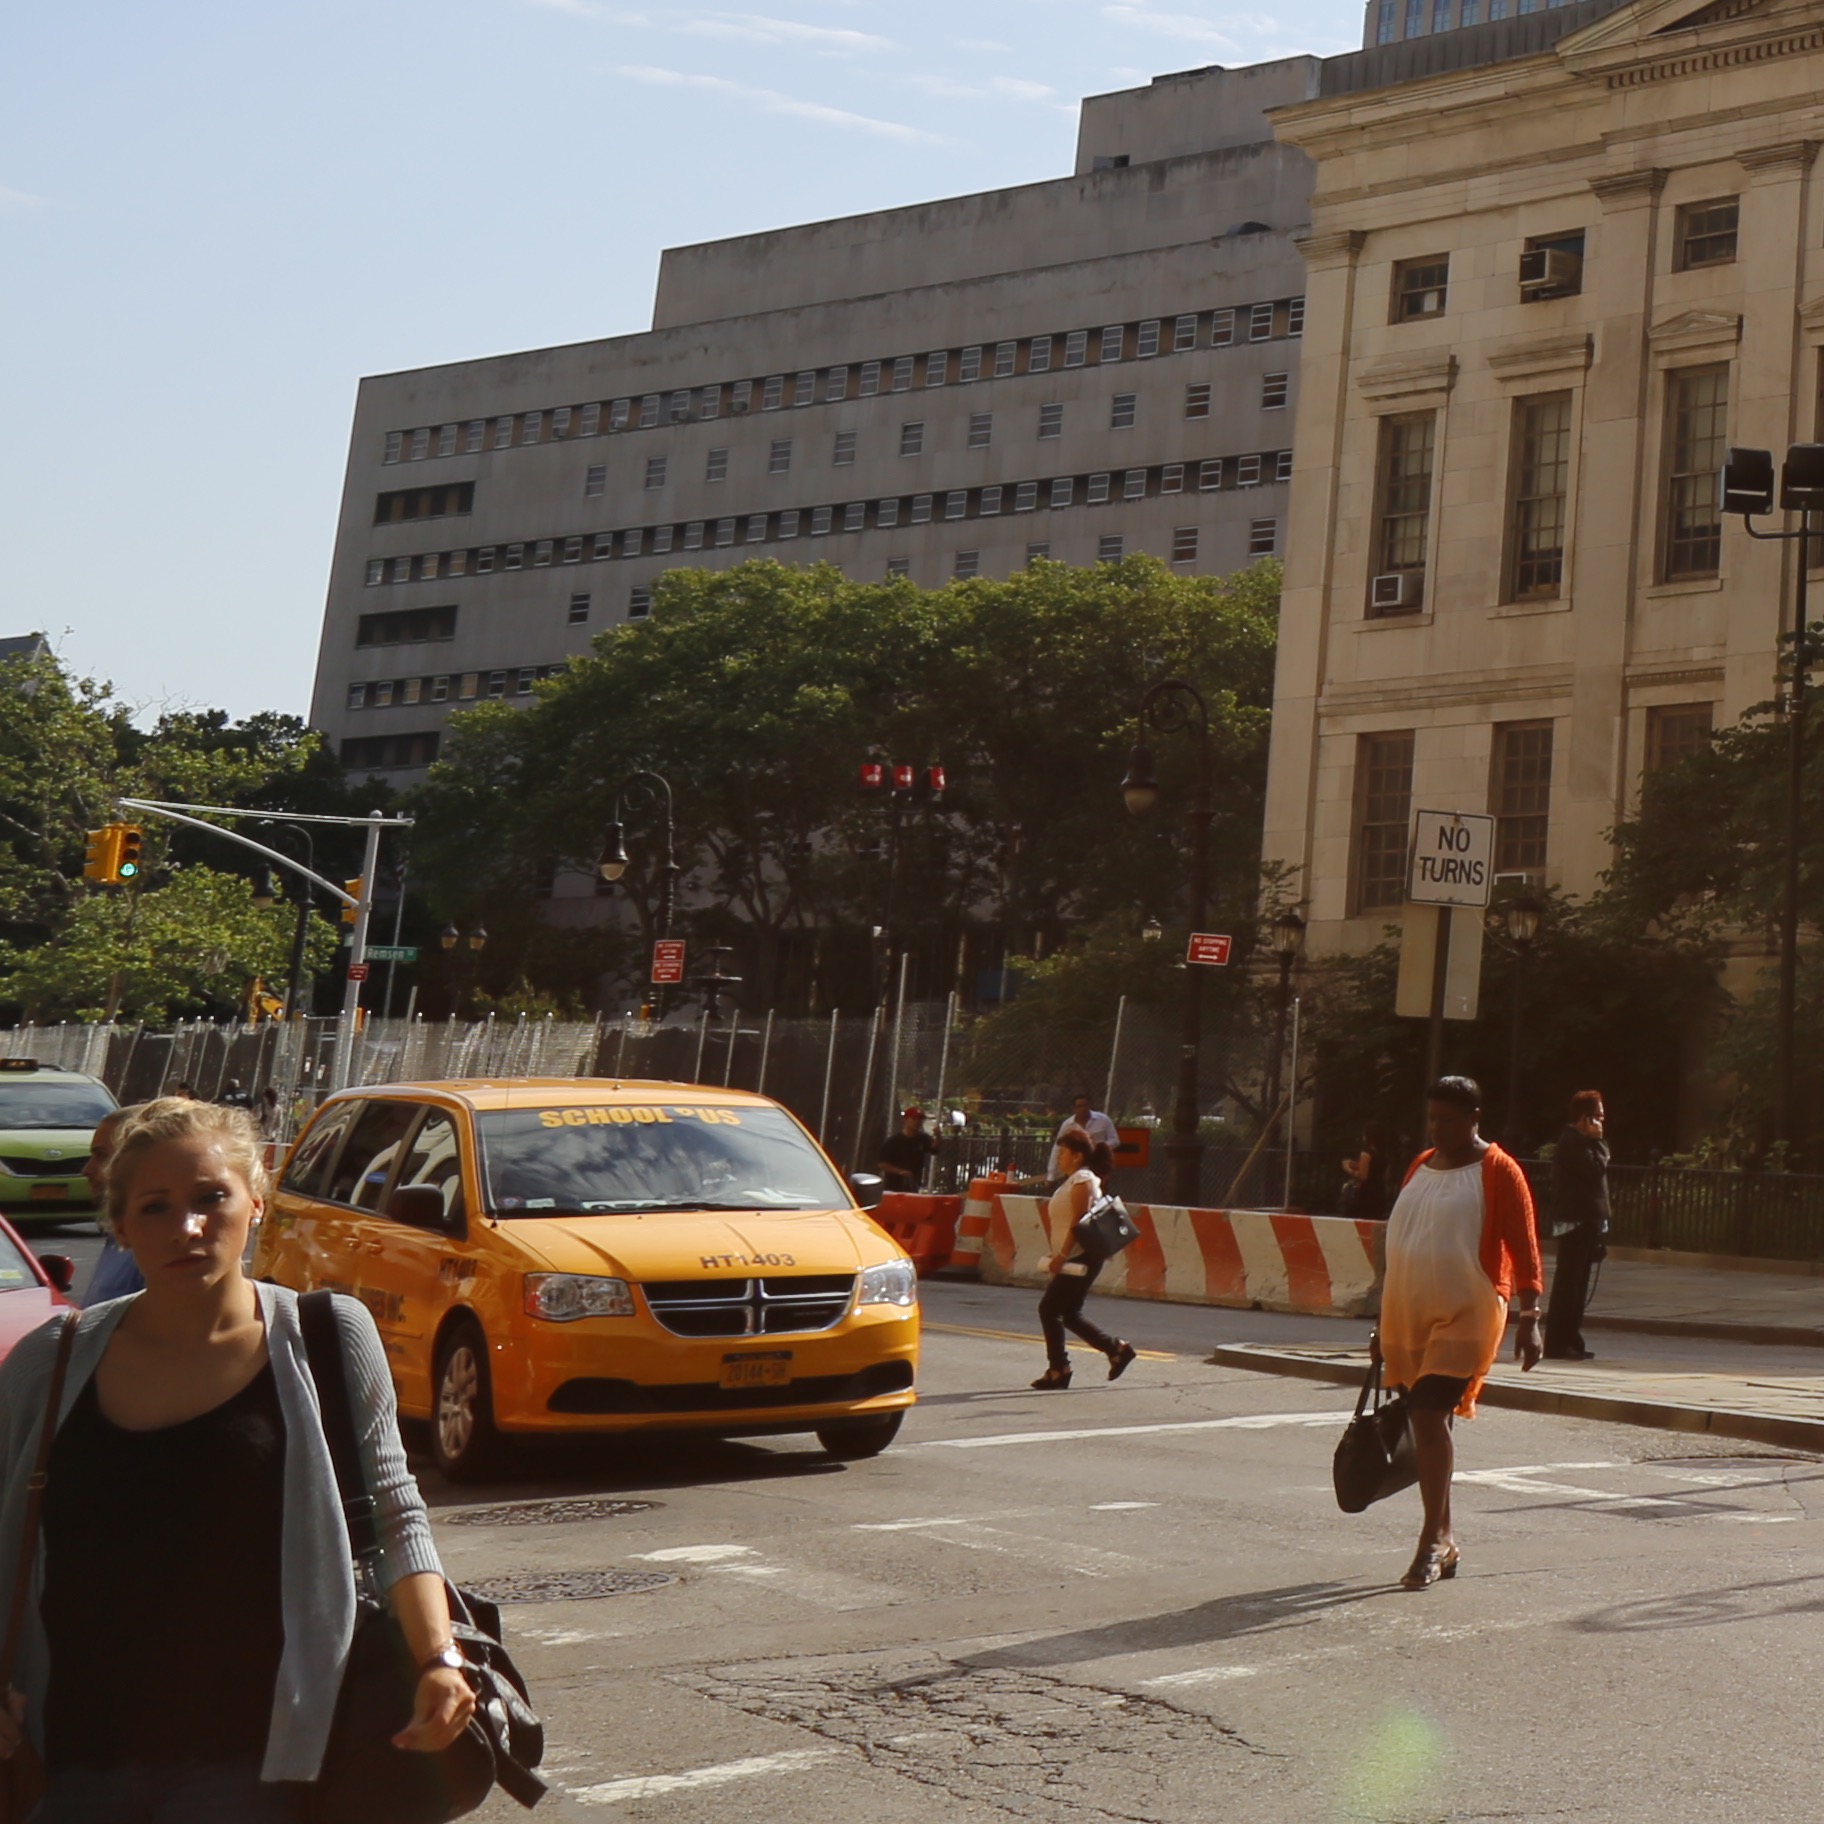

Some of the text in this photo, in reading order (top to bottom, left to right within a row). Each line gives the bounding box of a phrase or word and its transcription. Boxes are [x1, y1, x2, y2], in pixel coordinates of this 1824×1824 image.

[1438, 825, 1471, 853] NO
[1419, 857, 1484, 885] TURNS
[367, 948, 405, 960] Remsen
[538, 1107, 673, 1127] SCHOOL
[699, 1253, 796, 1269] HT1403
